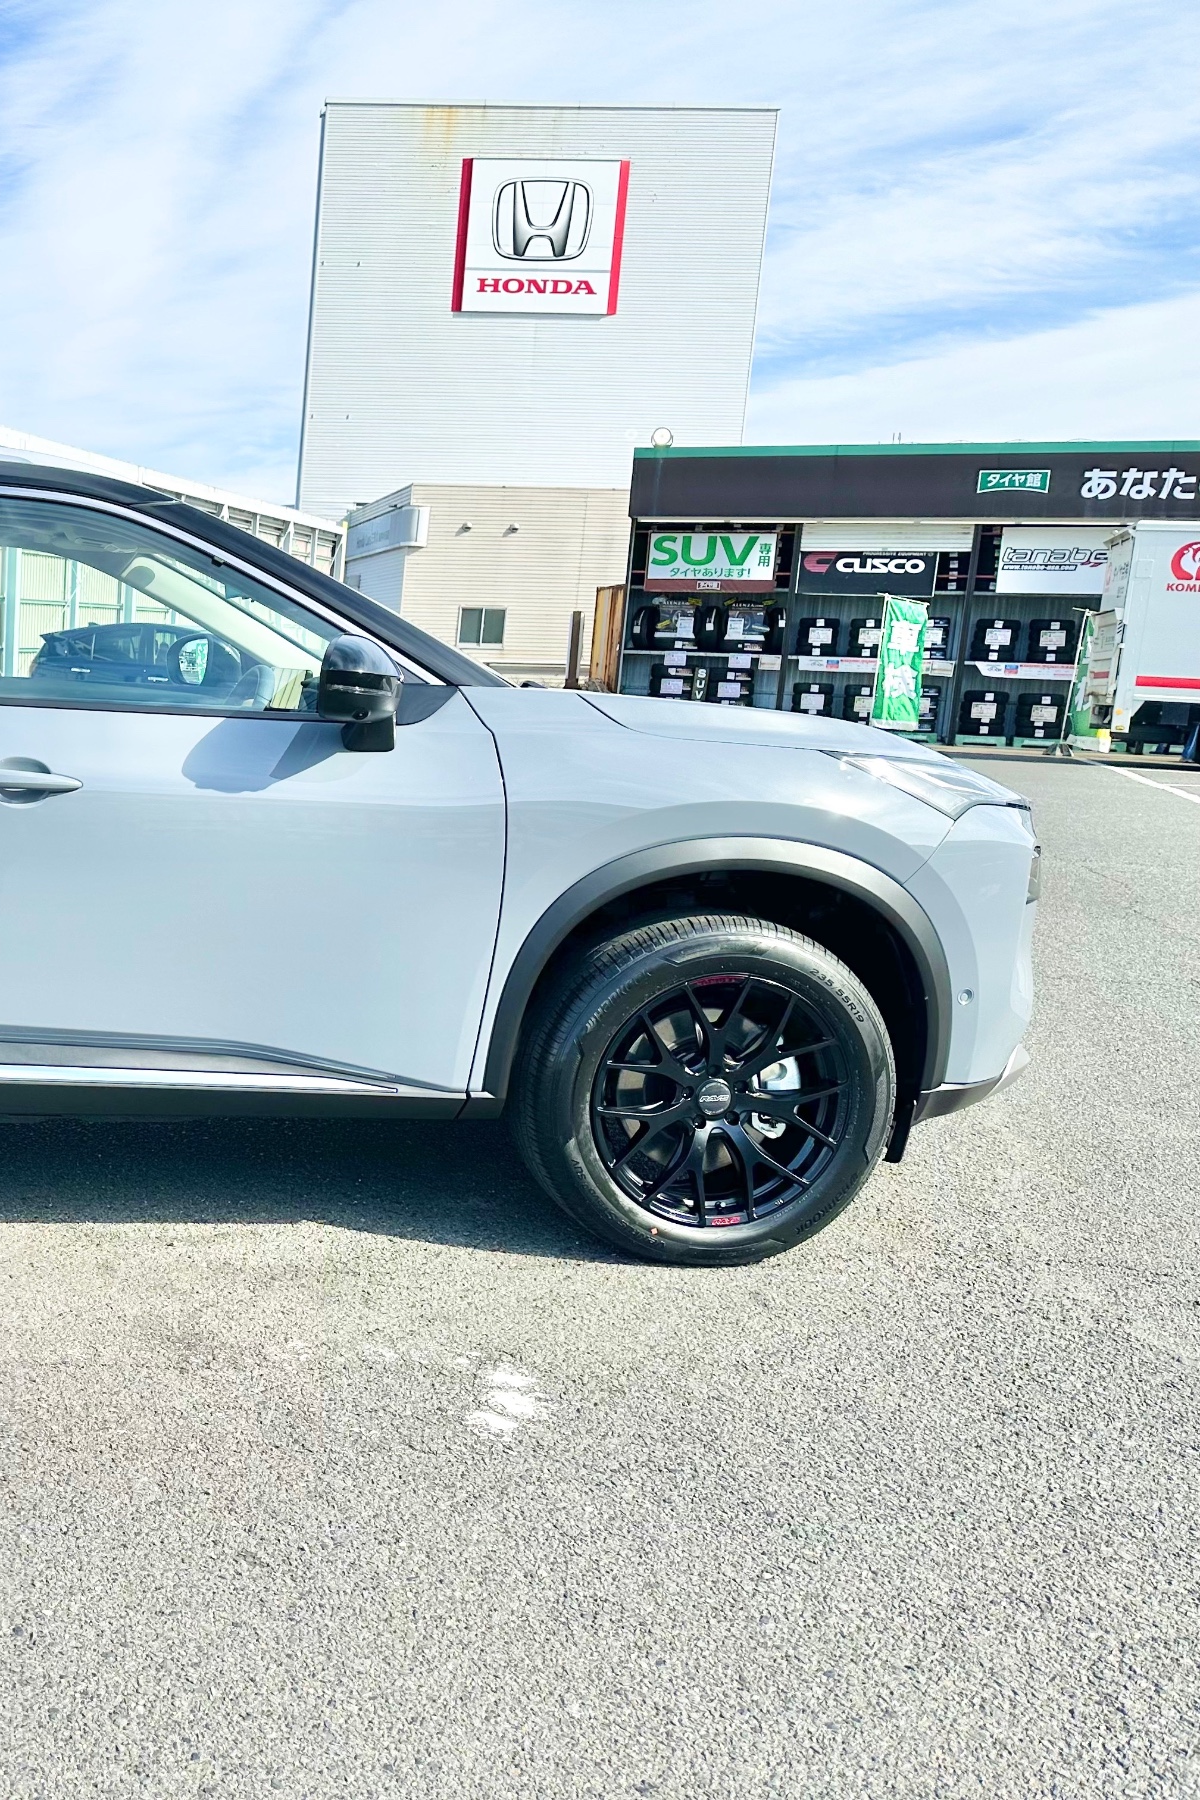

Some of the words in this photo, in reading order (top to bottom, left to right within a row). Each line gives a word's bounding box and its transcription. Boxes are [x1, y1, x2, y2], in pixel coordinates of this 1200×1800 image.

[476, 278, 597, 295] HONDA
[986, 472, 1042, 488] タイヤ館
[650, 535, 760, 567] SUV
[757, 542, 773, 568] 専用
[1002, 547, 1109, 564] tanabe
[835, 557, 926, 574] CUSCO
[695, 668, 707, 700] SUV
[808, 967, 865, 1024] 235/55R19
